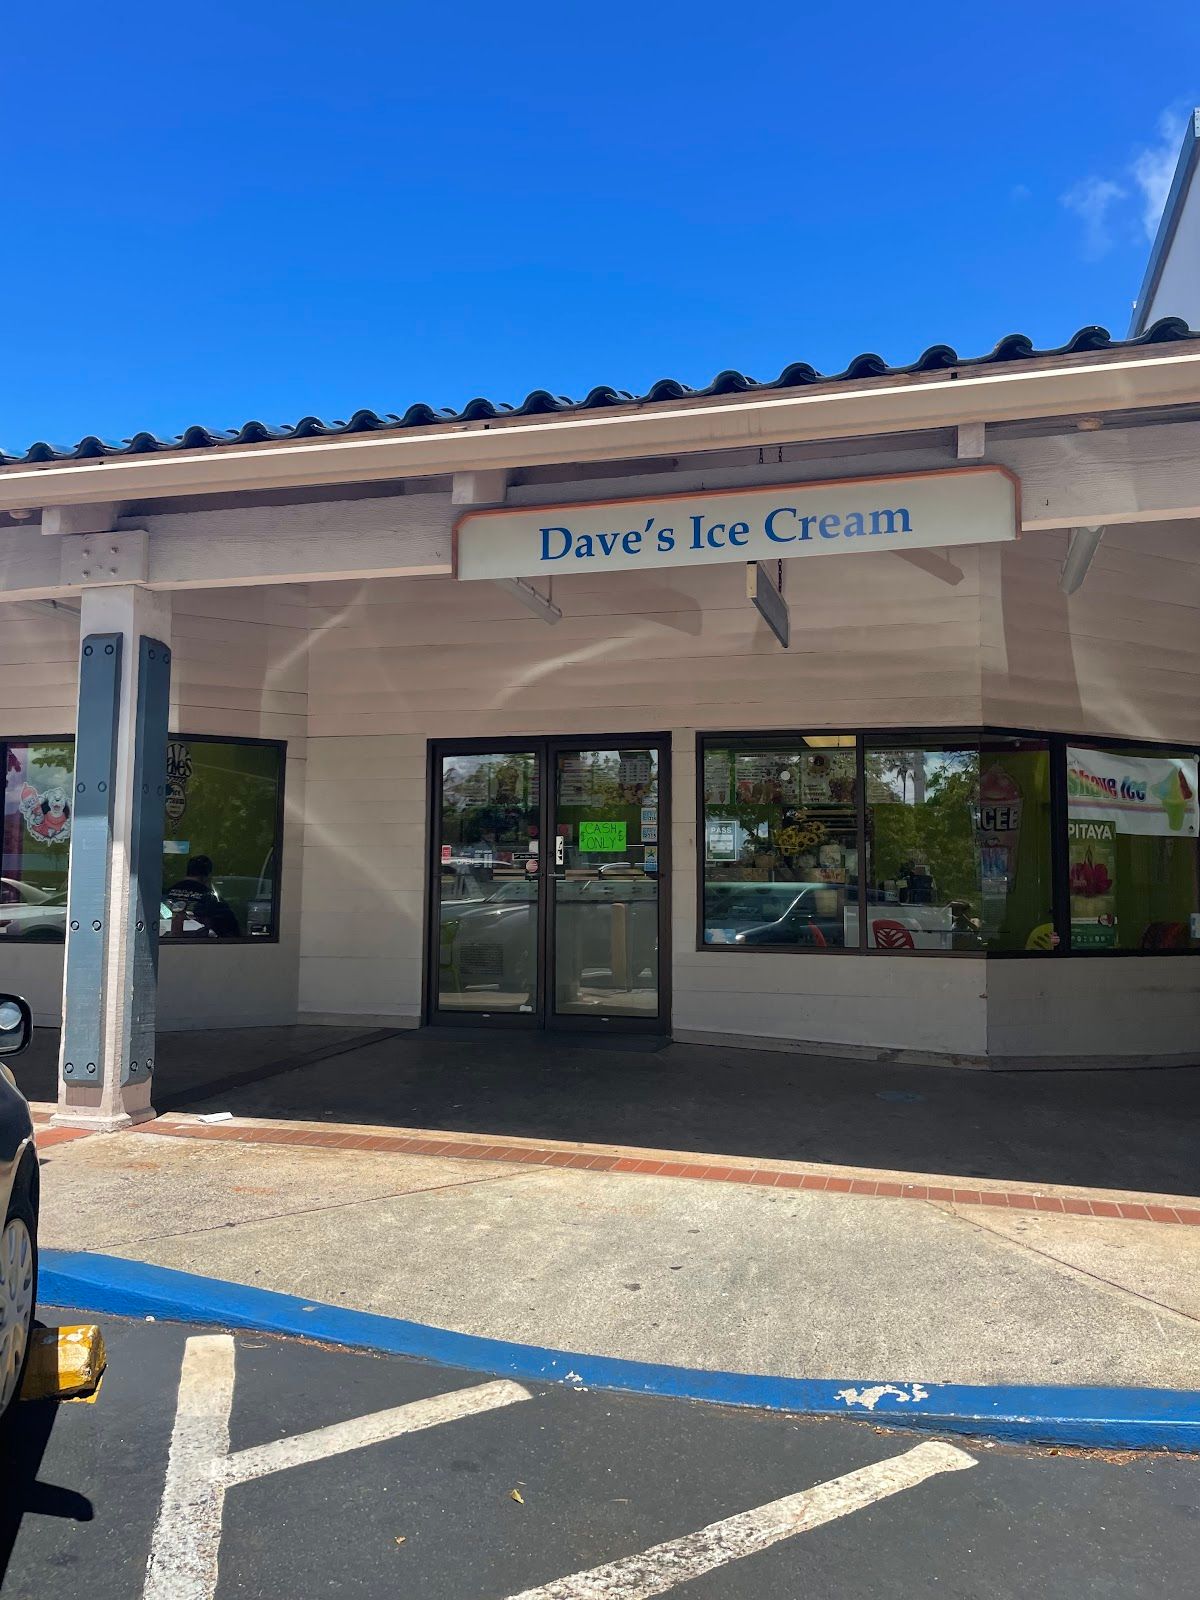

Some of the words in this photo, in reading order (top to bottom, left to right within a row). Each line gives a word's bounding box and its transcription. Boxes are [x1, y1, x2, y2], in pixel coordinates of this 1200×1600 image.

[539, 518, 675, 560] Dave's
[690, 515, 750, 549] Ice
[764, 507, 913, 543] Cream
[585, 823, 617, 834] CASH
[1068, 823, 1112, 840] PITAYA
[587, 834, 616, 849] ONLY
